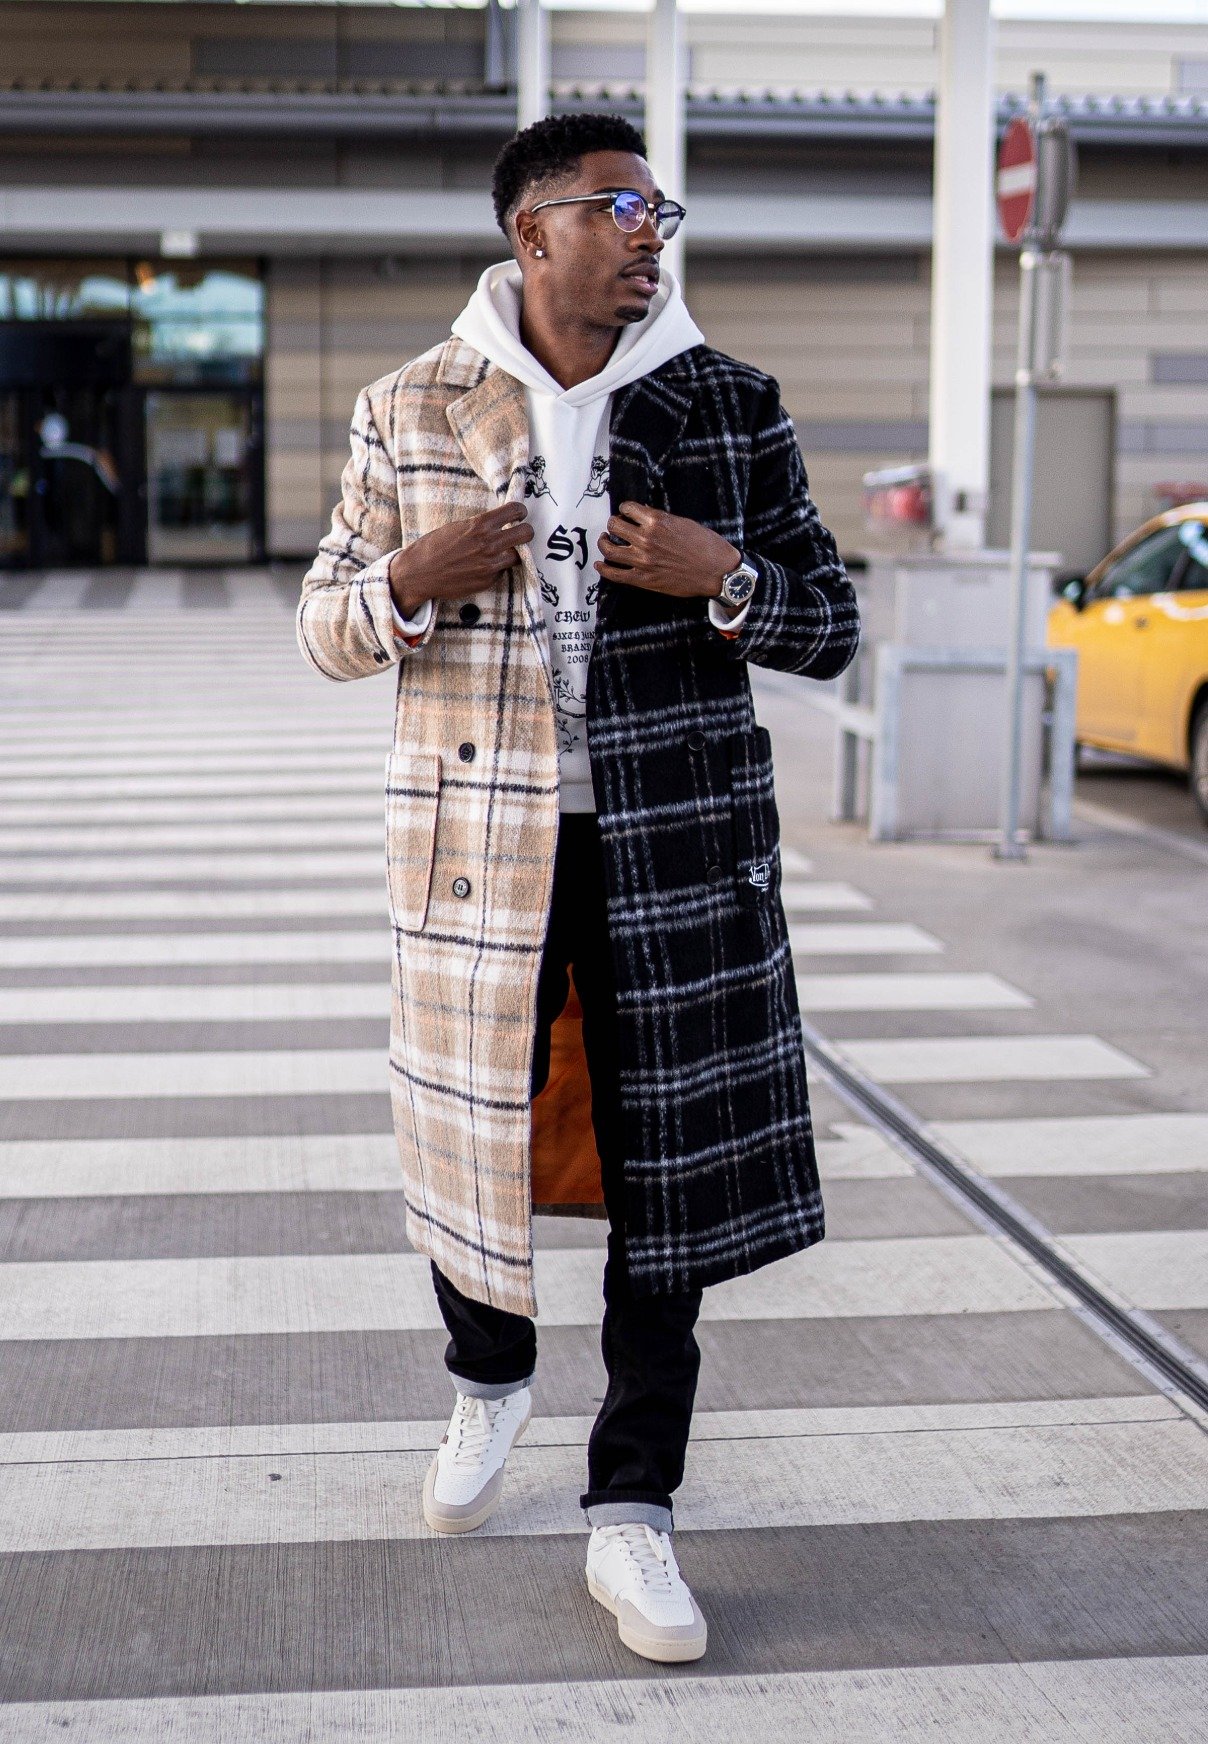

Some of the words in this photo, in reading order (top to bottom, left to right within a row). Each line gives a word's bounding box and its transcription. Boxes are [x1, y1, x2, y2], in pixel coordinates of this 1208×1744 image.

[554, 610, 591, 624] CREW
[552, 631, 580, 641] SIXTH
[581, 630, 596, 641] JUN
[561, 642, 591, 653] BRAND
[567, 654, 589, 664] 2008
